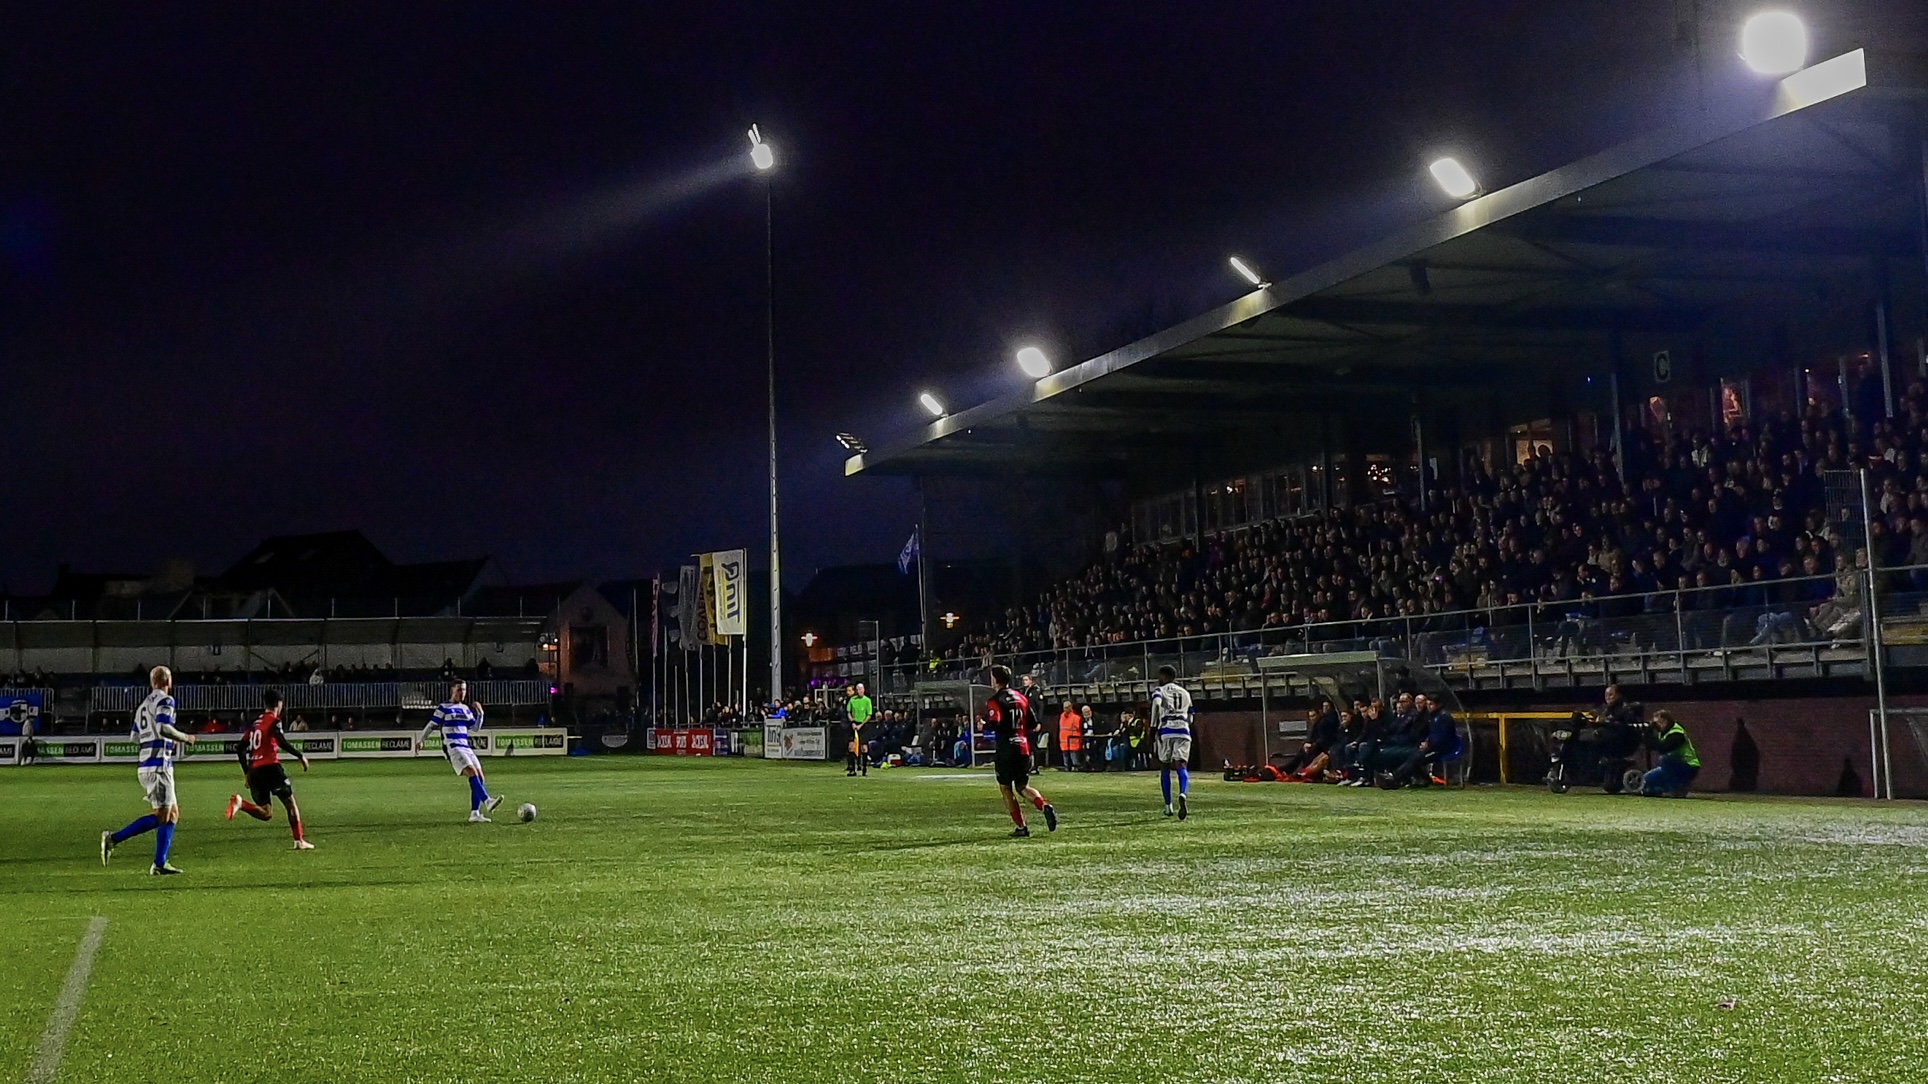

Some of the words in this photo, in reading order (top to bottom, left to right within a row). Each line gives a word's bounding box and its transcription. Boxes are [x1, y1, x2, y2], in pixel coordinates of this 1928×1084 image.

[1656, 353, 1668, 380] C
[1172, 692, 1183, 710] 11
[140, 706, 148, 730] 6
[1009, 708, 1024, 730] 12
[105, 745, 139, 753] TOMASSE
[342, 740, 380, 749] TOMASSEN
[381, 740, 411, 748] RECLAME
